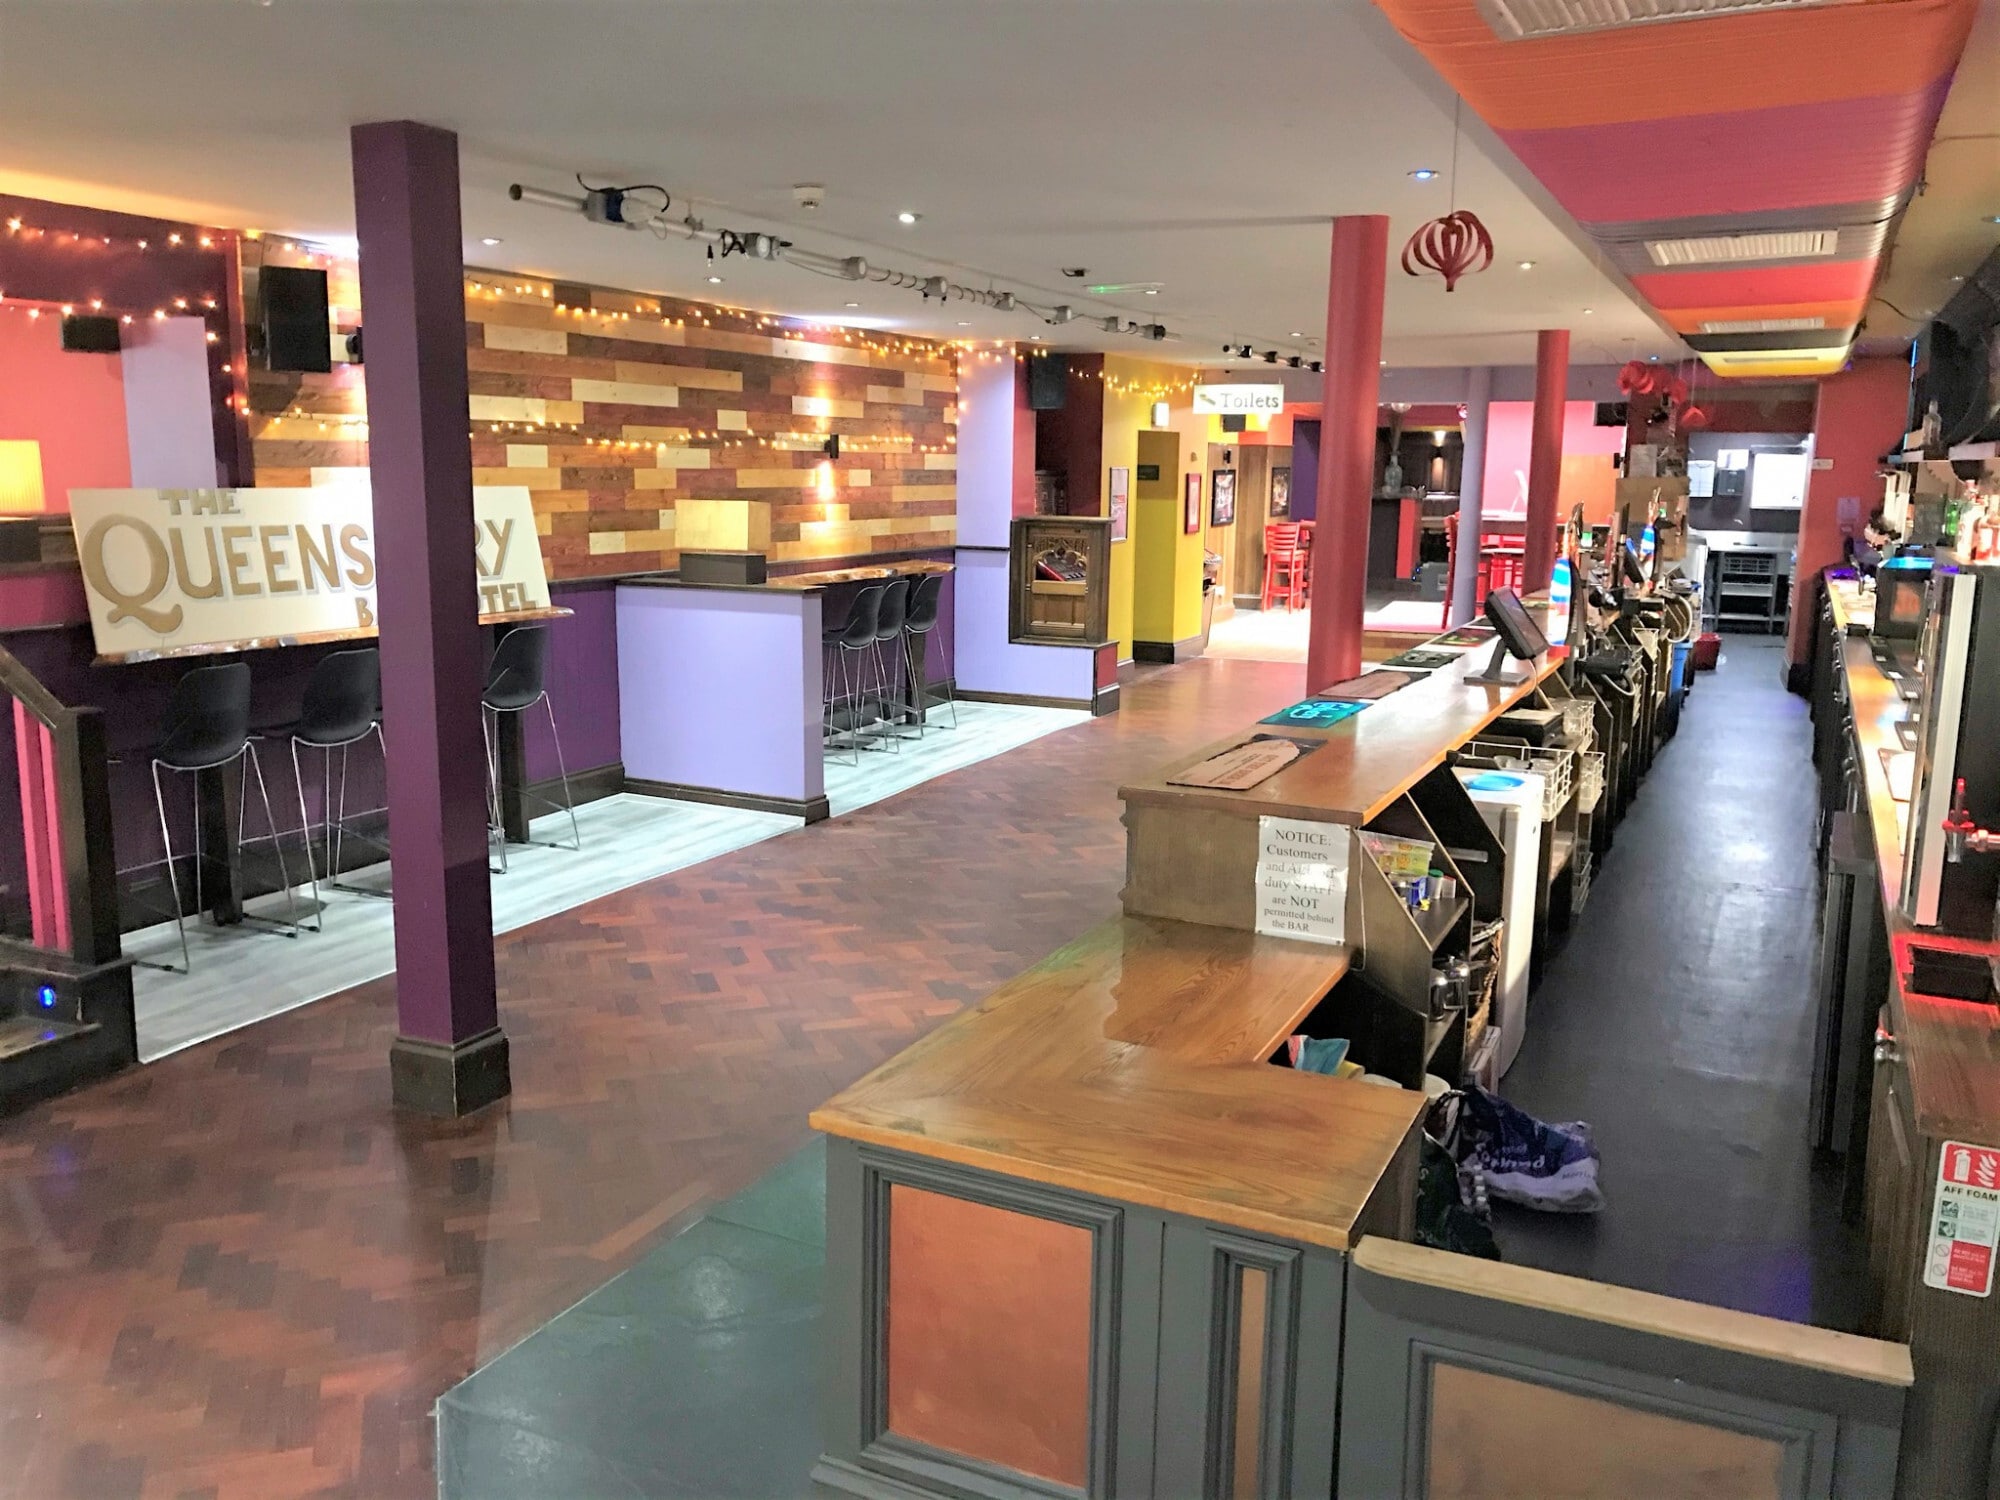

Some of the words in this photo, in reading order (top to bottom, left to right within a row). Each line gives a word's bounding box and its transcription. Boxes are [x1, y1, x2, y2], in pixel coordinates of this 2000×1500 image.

[1220, 392, 1279, 408] Toilets
[158, 488, 240, 516] THE
[1266, 844, 1329, 861] Customers
[1265, 862, 1285, 872] and
[1264, 876, 1290, 892] duty
[1272, 896, 1286, 905] are
[1290, 895, 1320, 909] NOT
[1263, 908, 1305, 920] permitted
[1306, 912, 1335, 924] behind
[1271, 918, 1285, 928] the
[1287, 920, 1310, 932] BAR
[1943, 1185, 1963, 1196] AFF
[1966, 1189, 1999, 1202] FOAM
